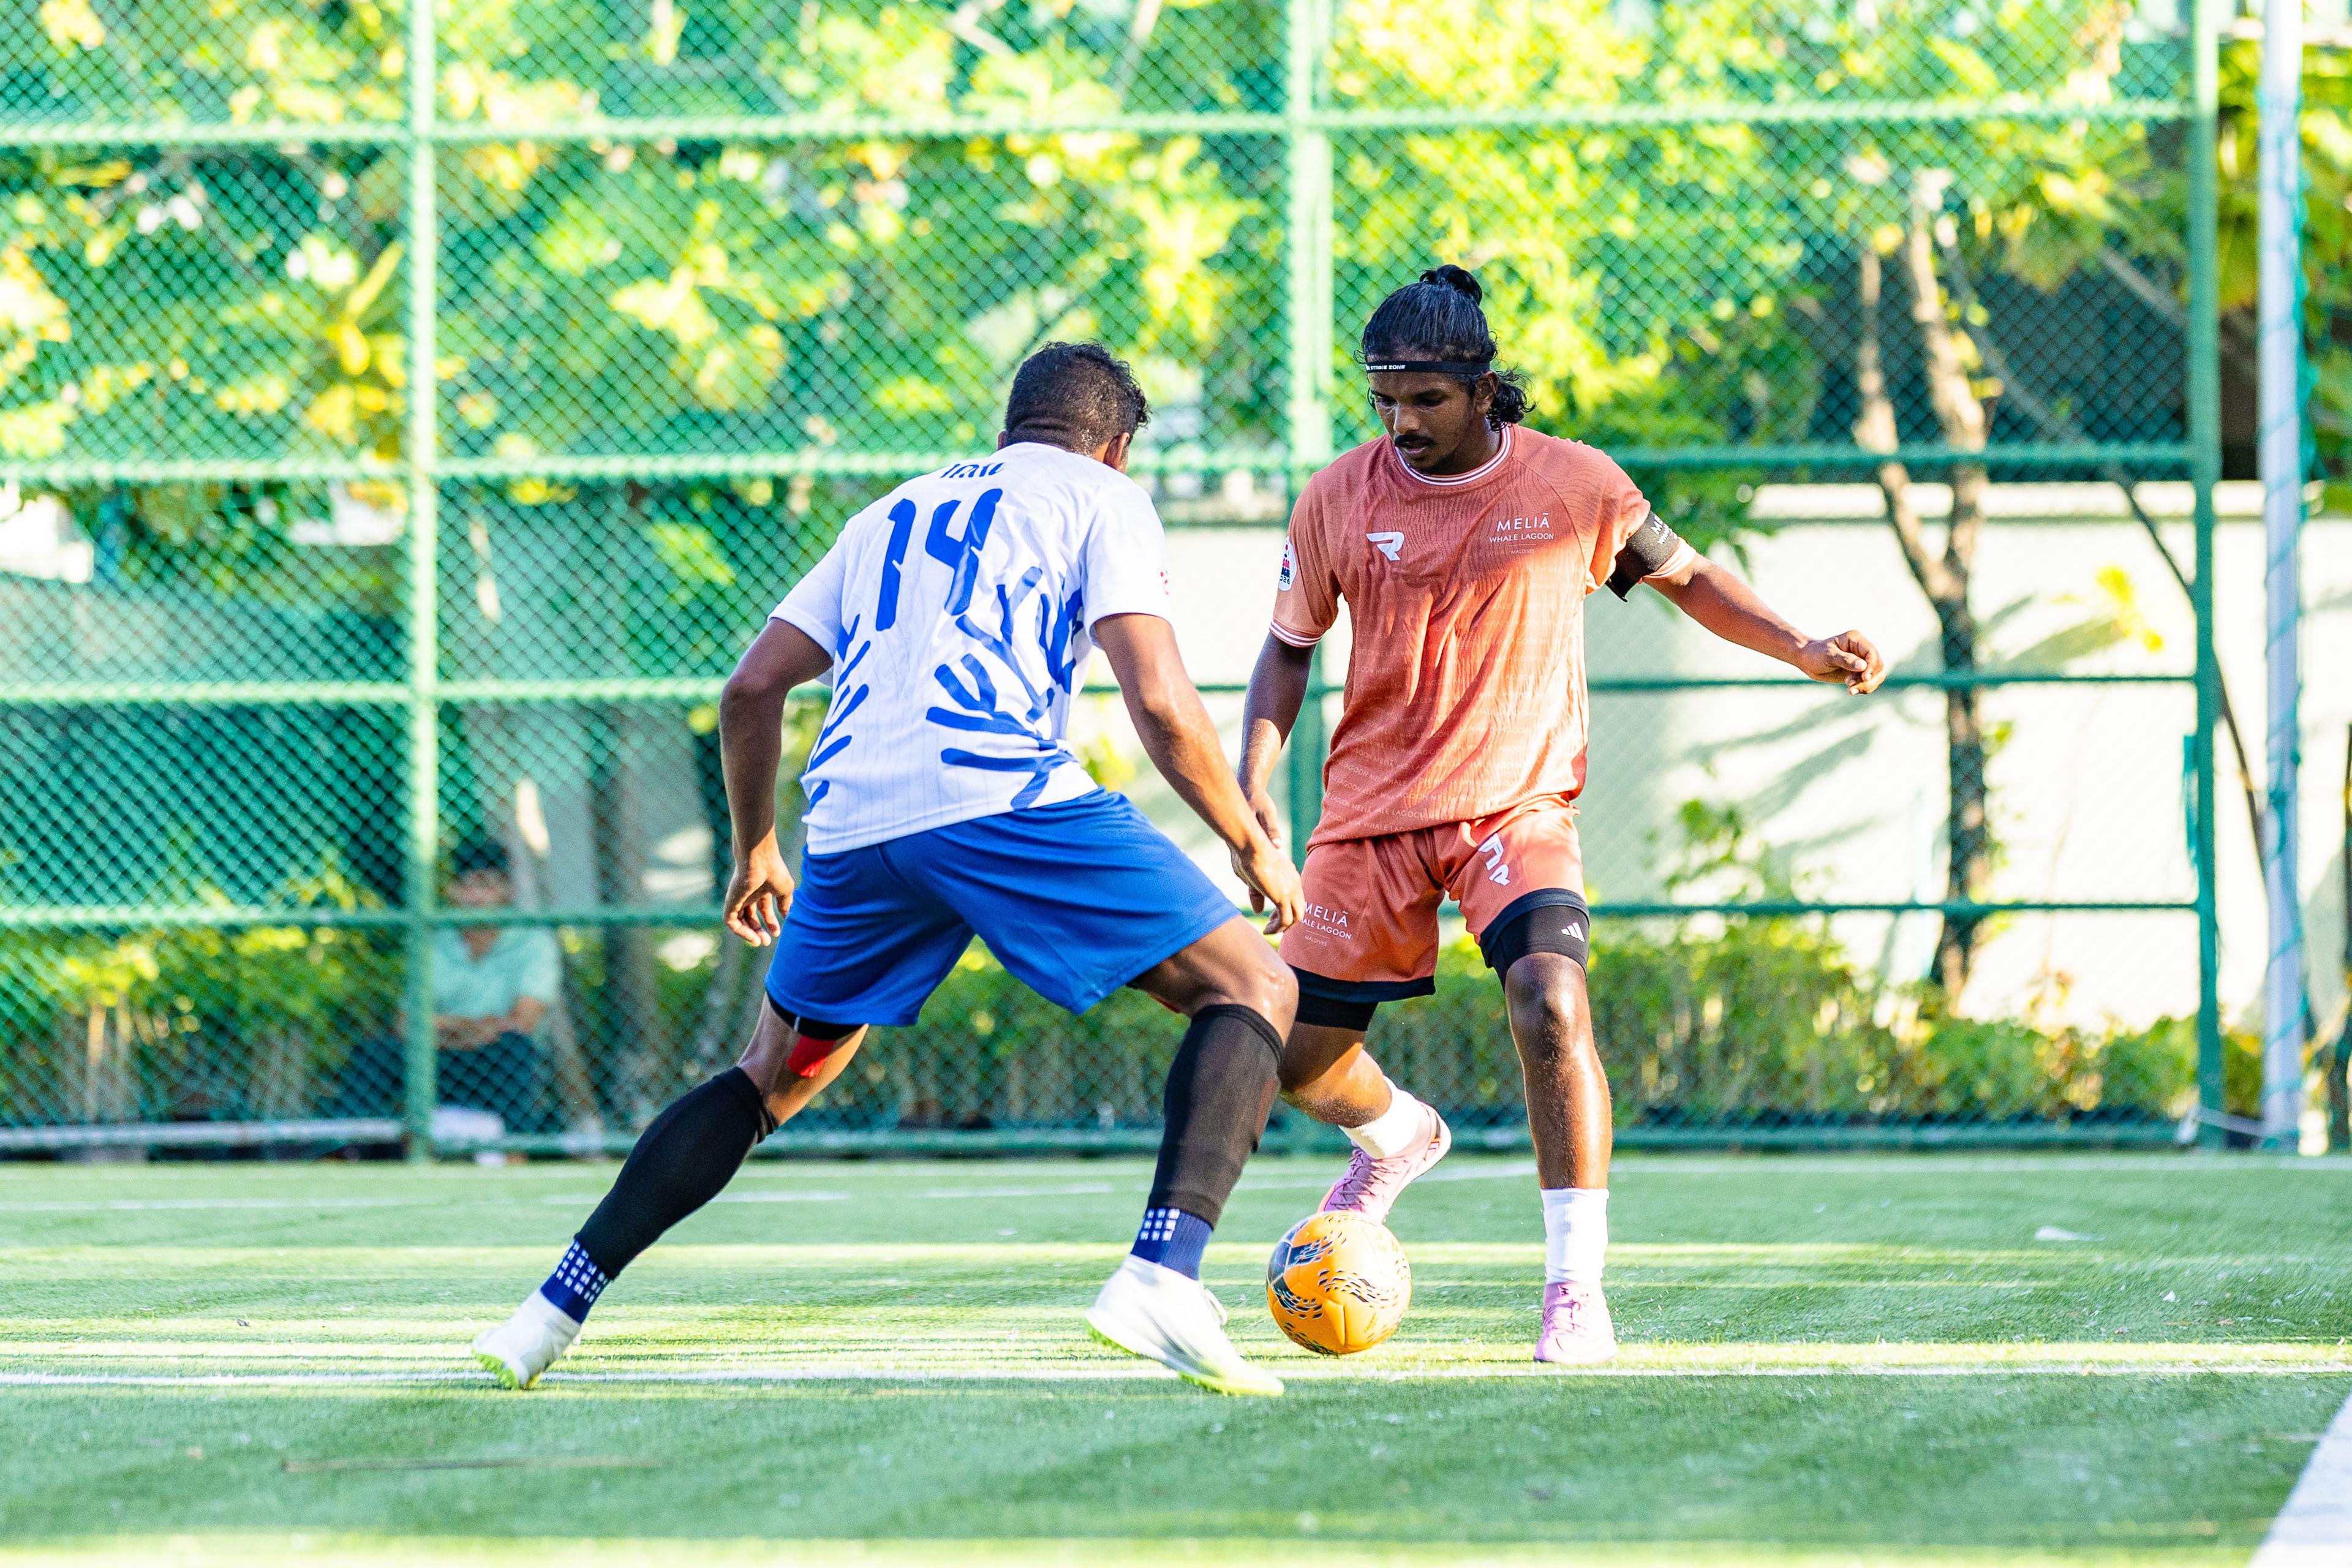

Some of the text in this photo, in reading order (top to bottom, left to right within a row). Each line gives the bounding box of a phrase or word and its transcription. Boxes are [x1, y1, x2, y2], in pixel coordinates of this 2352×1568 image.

[1496, 511, 1550, 532] MELIÃ
[1490, 533, 1518, 543] WHALE
[875, 488, 1003, 631] 14
[1317, 923, 1352, 940] LAGOON
